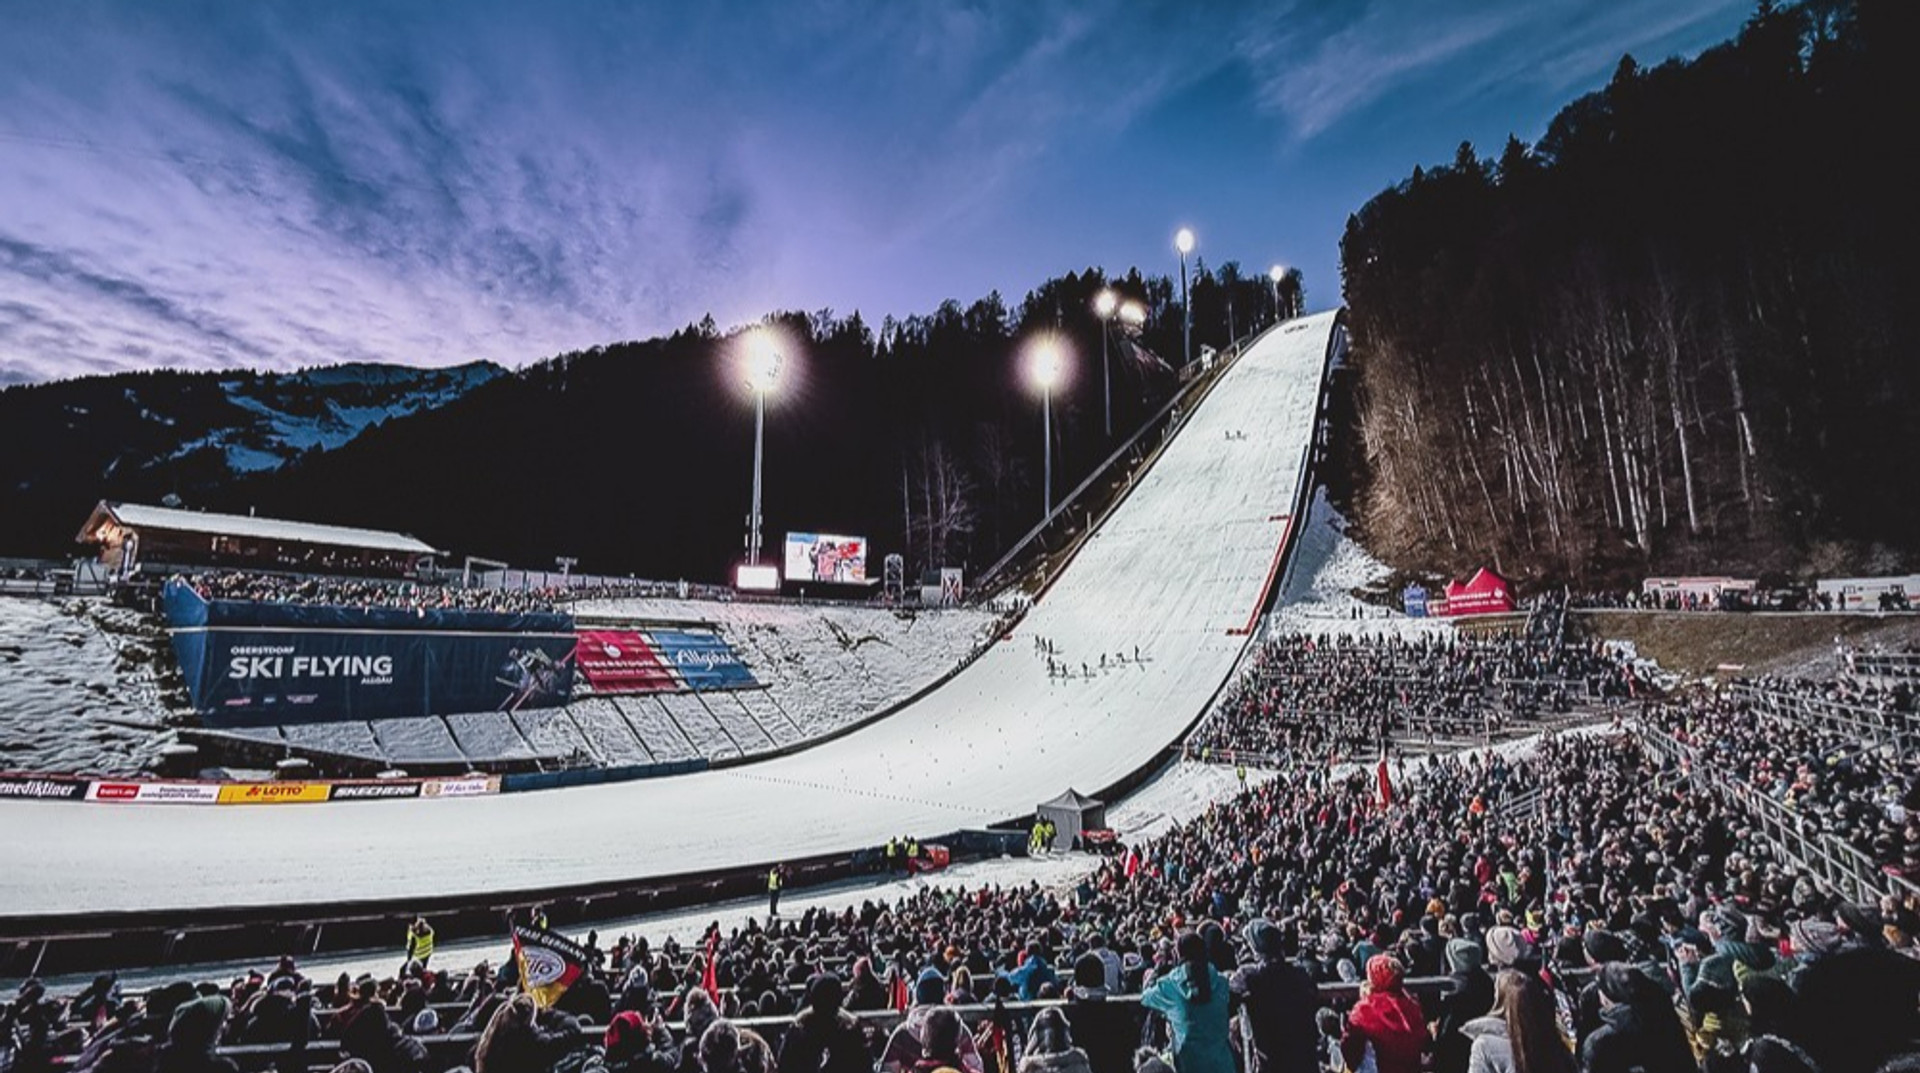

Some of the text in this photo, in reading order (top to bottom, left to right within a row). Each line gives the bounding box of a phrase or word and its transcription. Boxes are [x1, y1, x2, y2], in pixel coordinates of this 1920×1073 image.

[230, 645, 295, 655] OBERSTDORF
[228, 656, 393, 679] SKI FLYING
[263, 786, 303, 796] LOTTO
[334, 785, 418, 798] SKECHERS
[541, 935, 587, 961] GERMANY
